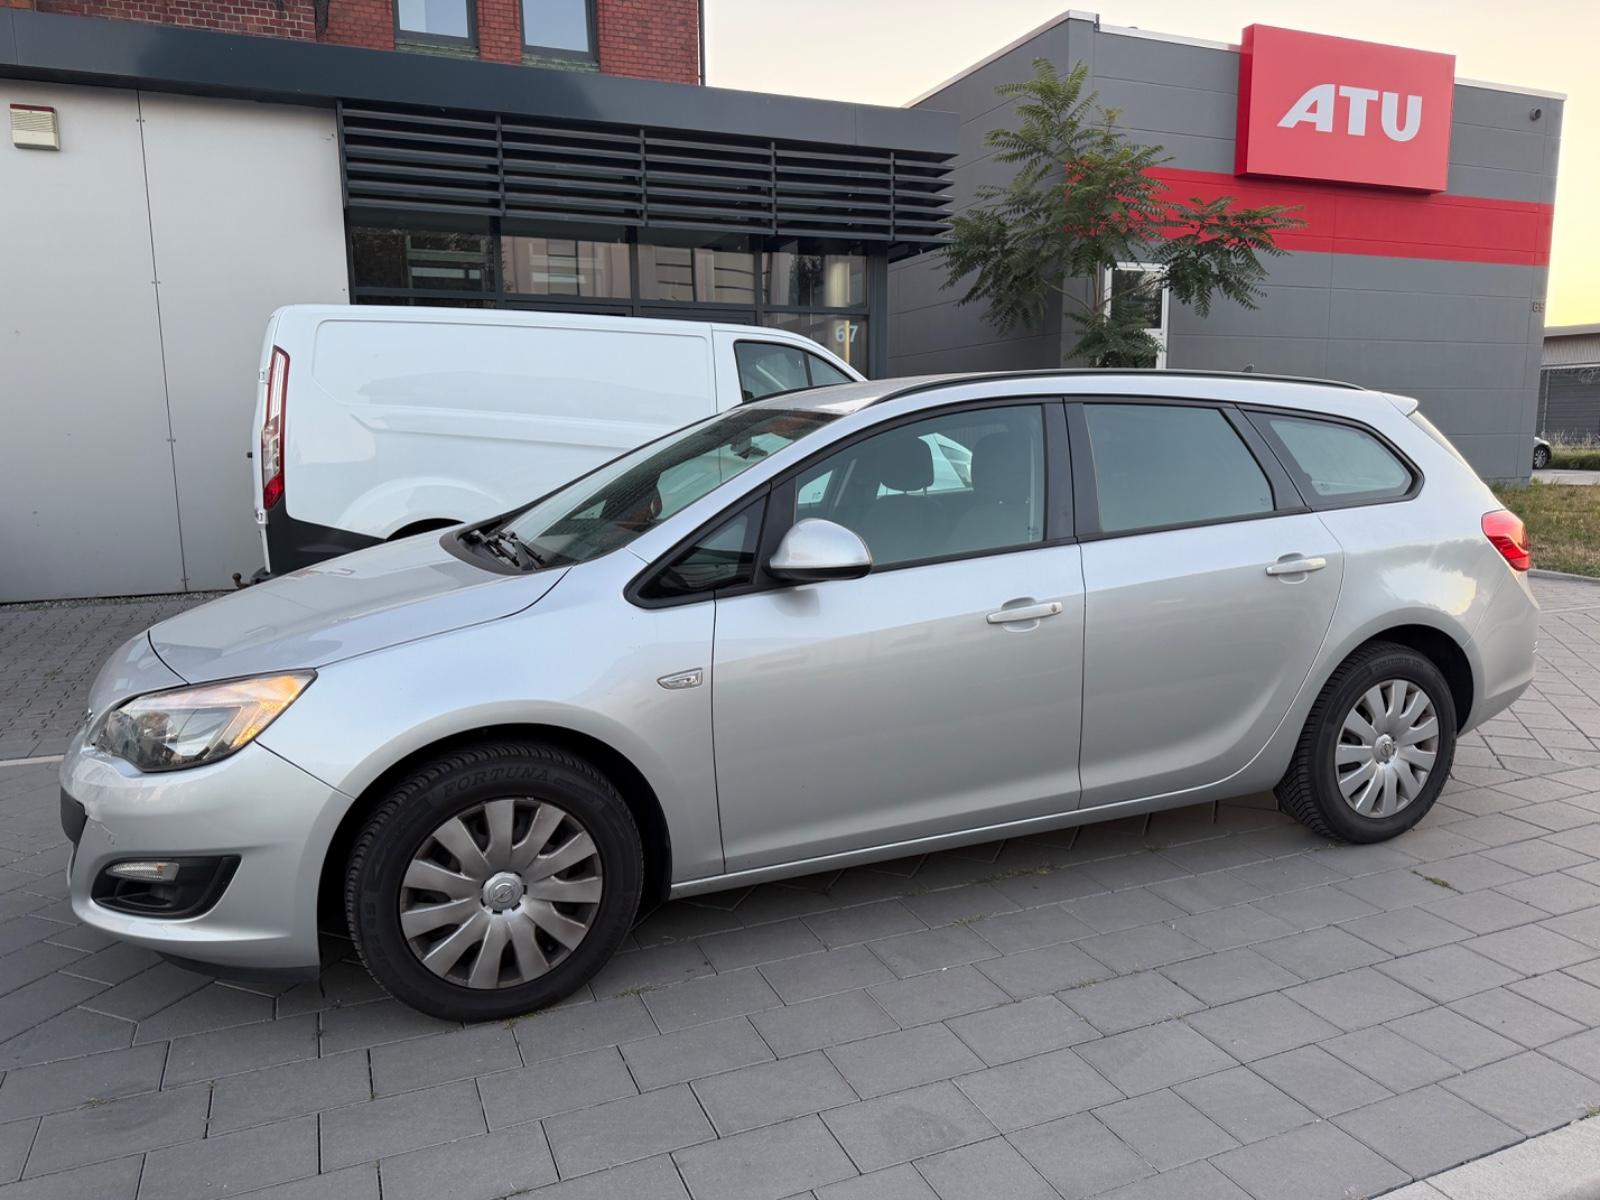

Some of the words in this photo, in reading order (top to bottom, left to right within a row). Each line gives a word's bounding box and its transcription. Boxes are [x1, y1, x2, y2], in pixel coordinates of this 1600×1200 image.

[1276, 83, 1423, 143] ATU
[835, 325, 859, 343] 67
[443, 766, 549, 799] FORTUNA
